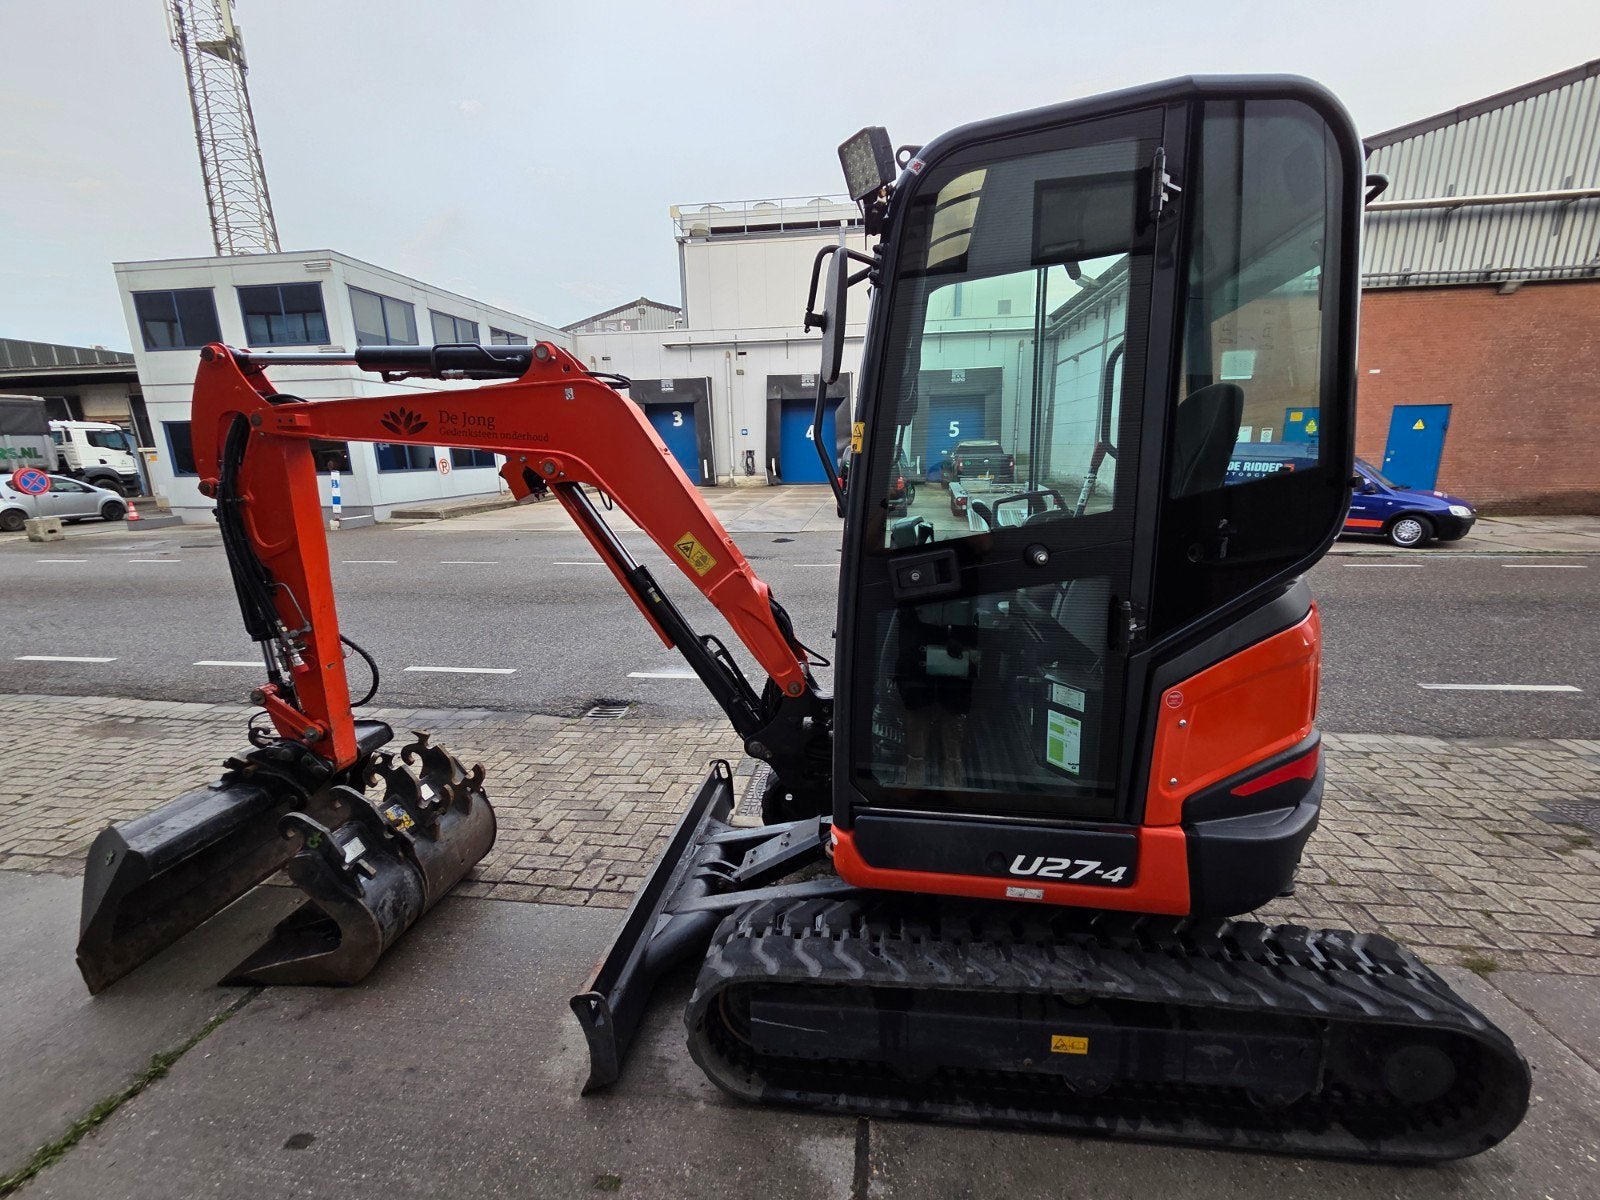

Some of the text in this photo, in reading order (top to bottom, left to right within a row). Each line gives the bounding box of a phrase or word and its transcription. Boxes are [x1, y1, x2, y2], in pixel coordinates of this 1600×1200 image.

[438, 410, 495, 431] De Jong
[672, 410, 683, 427] 3
[440, 427, 549, 442] Gedenksteen onderhoud
[805, 424, 815, 441] 4
[949, 421, 960, 438] 5
[1227, 461, 1241, 471] DE
[1009, 854, 1127, 883] U27-4
